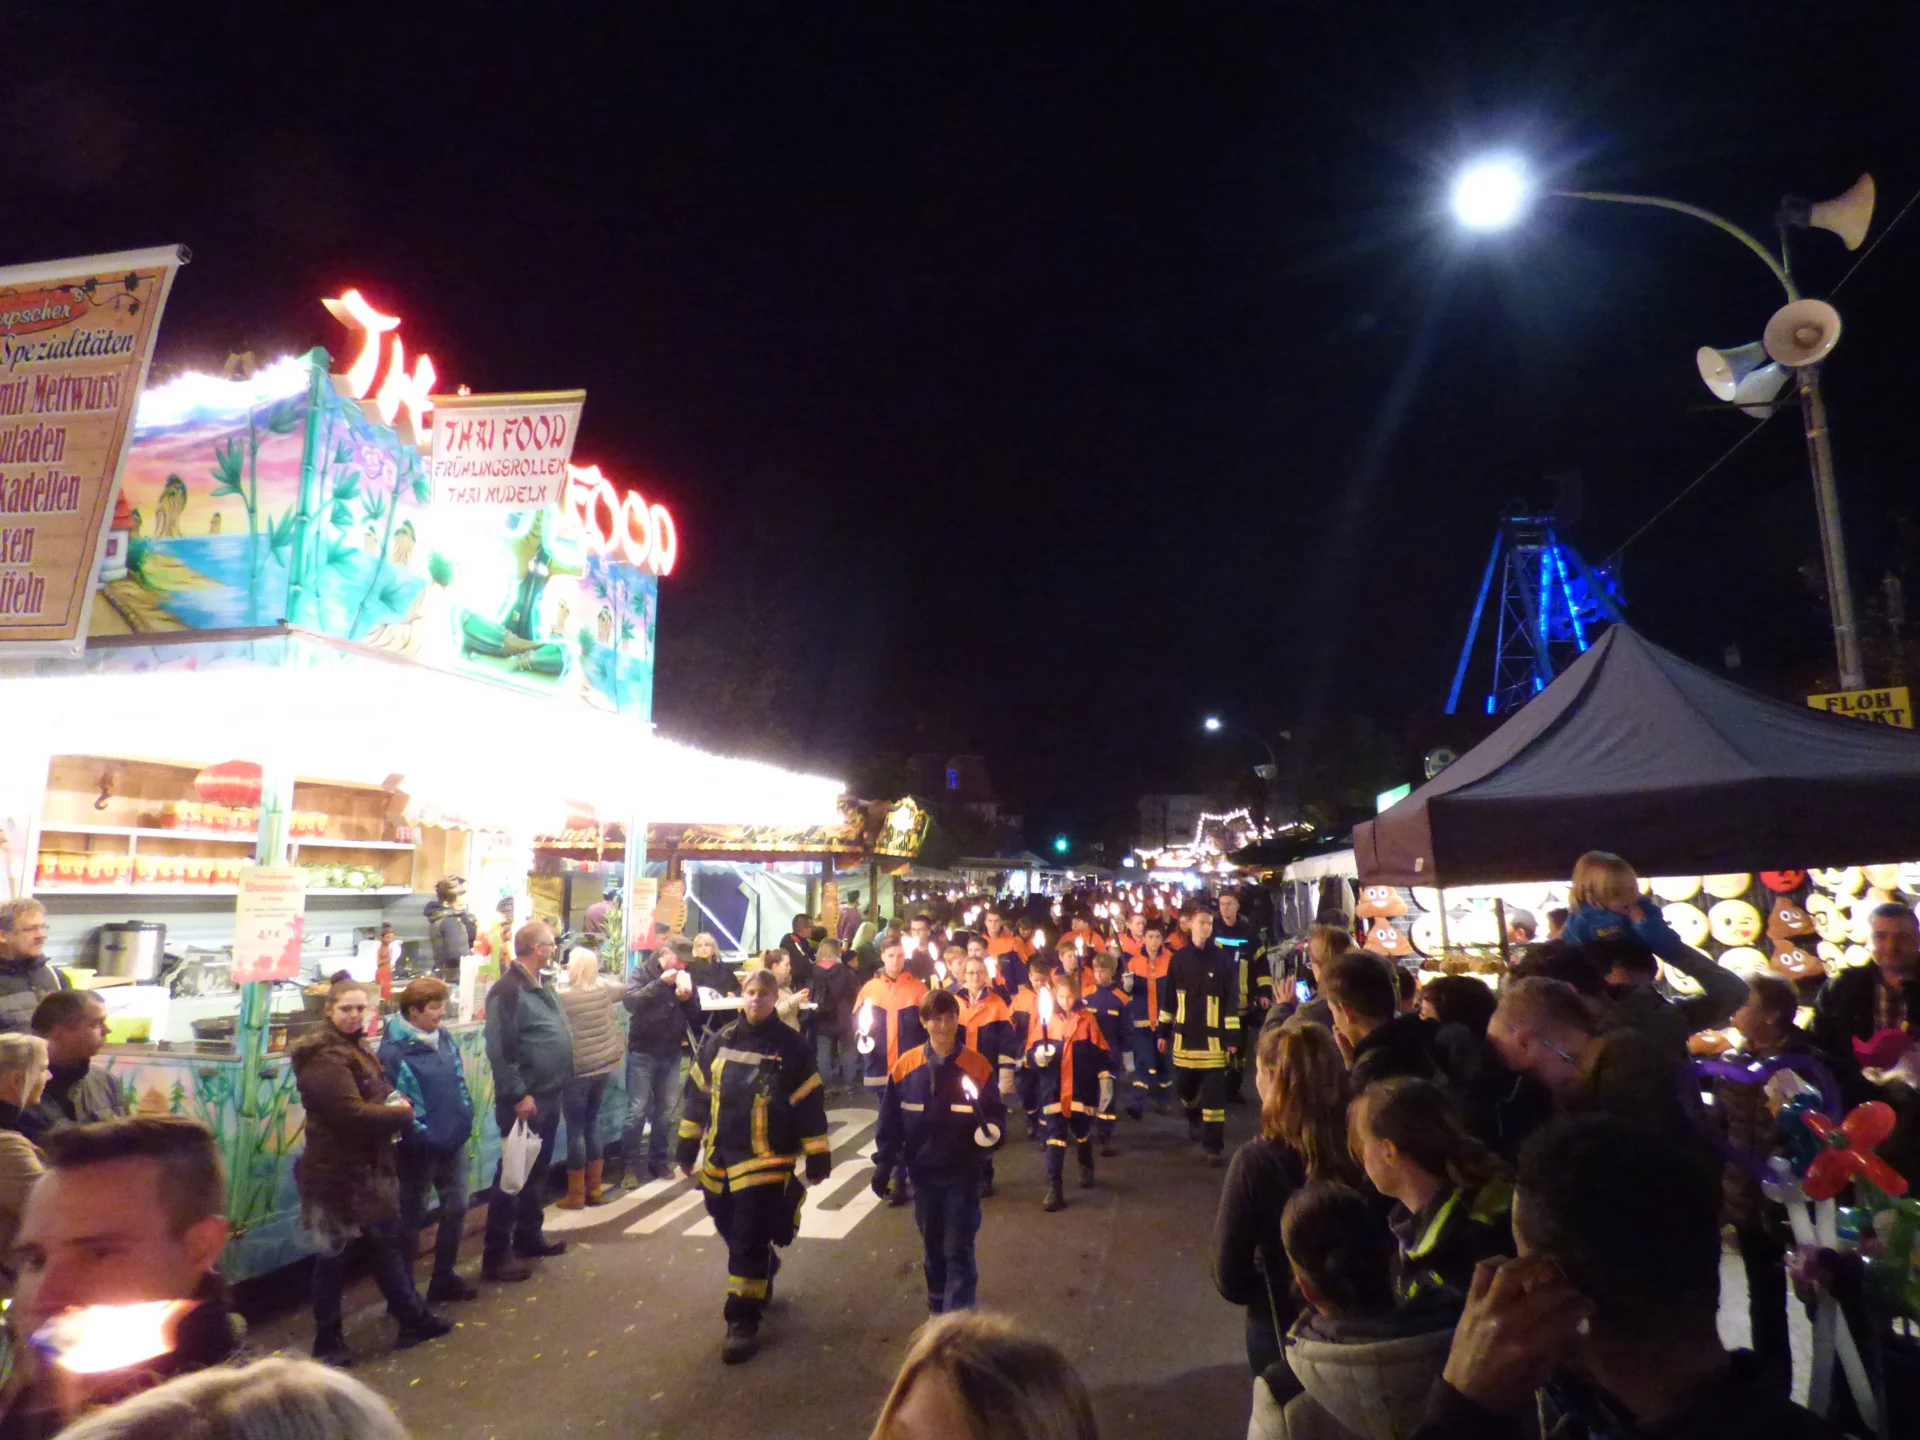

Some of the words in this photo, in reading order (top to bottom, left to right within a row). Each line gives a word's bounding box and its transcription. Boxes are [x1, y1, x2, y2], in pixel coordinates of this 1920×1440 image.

[0, 328, 135, 373] Spezialitäten
[30, 372, 122, 414] Mettwurst
[0, 421, 66, 463] uladen
[445, 418, 495, 452] THAI
[503, 414, 566, 451] FOOD
[435, 455, 566, 478] FRÜHLINGSROLLEN
[448, 486, 481, 503] THAI
[485, 485, 547, 503] NUDELN
[1825, 692, 1892, 711] FLOH
